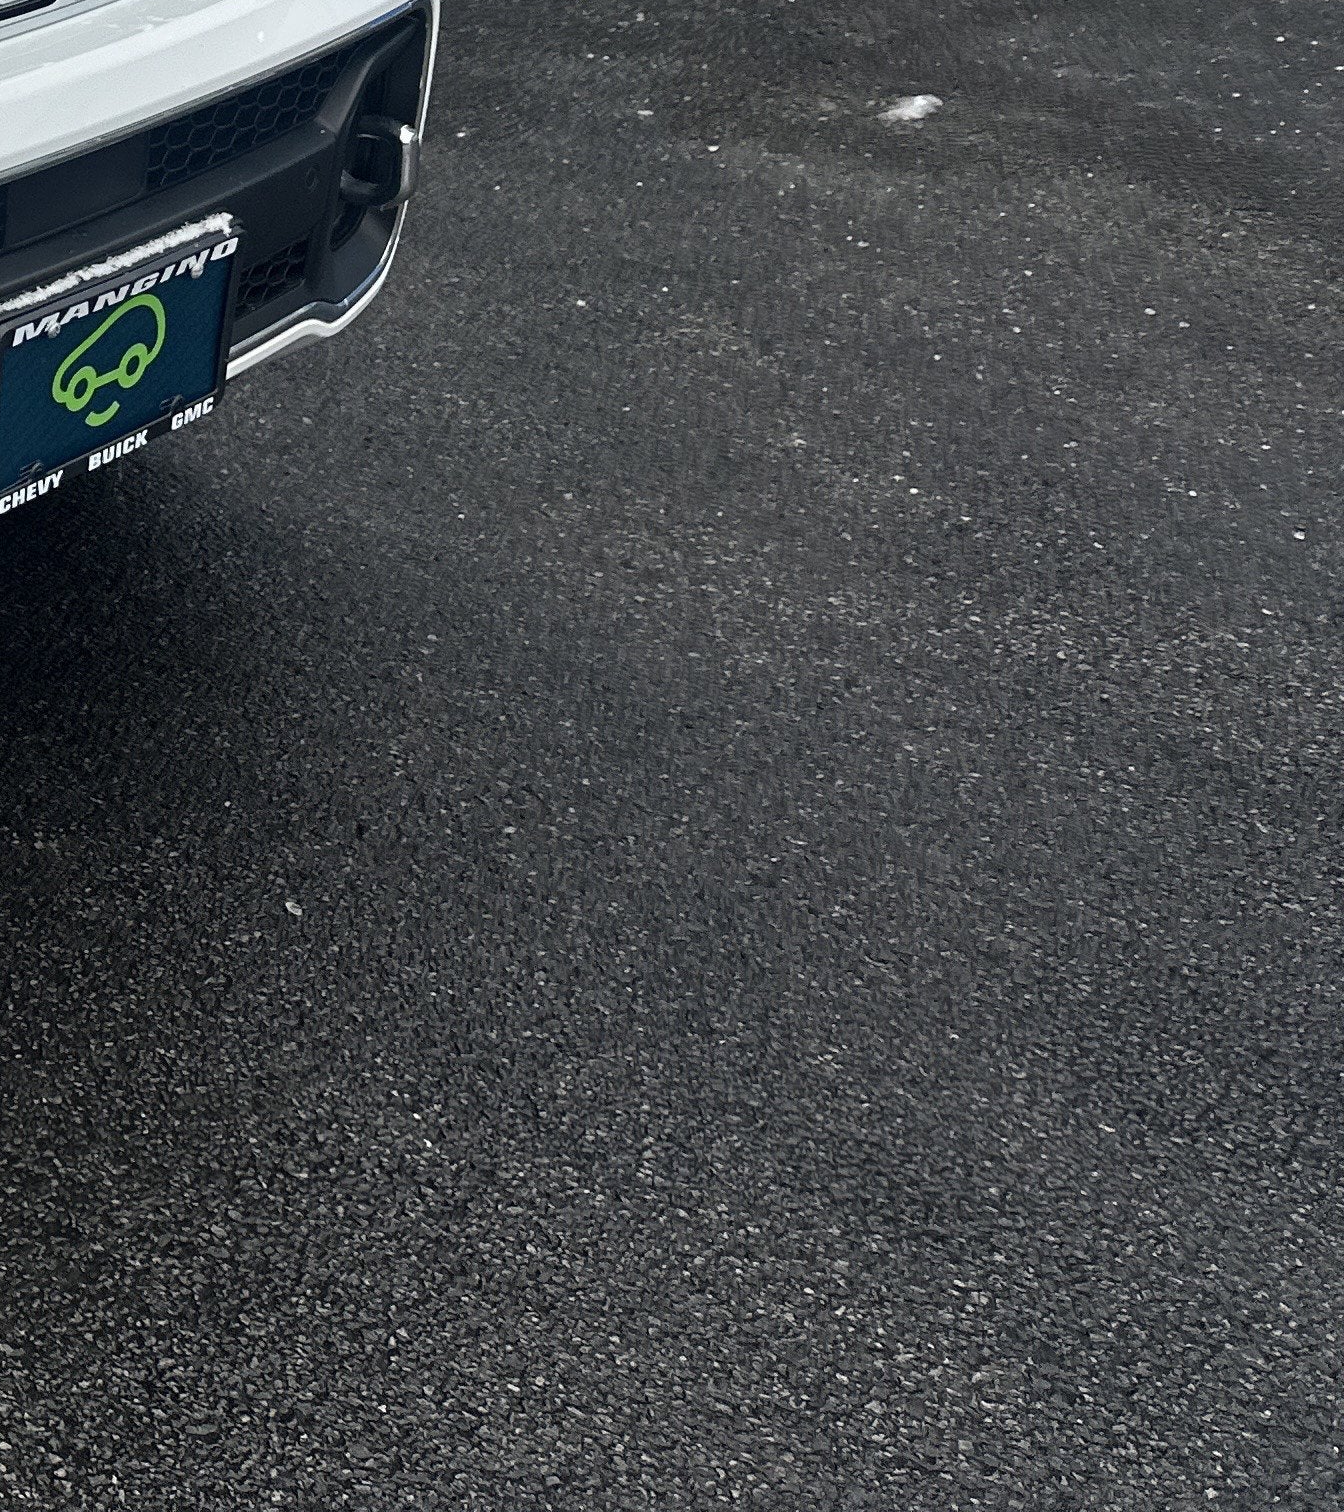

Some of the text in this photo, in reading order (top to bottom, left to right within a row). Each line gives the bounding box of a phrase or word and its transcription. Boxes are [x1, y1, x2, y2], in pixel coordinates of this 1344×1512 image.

[12, 237, 238, 347] MANGINO
[88, 429, 148, 472] BUICK
[171, 396, 214, 430] GMC
